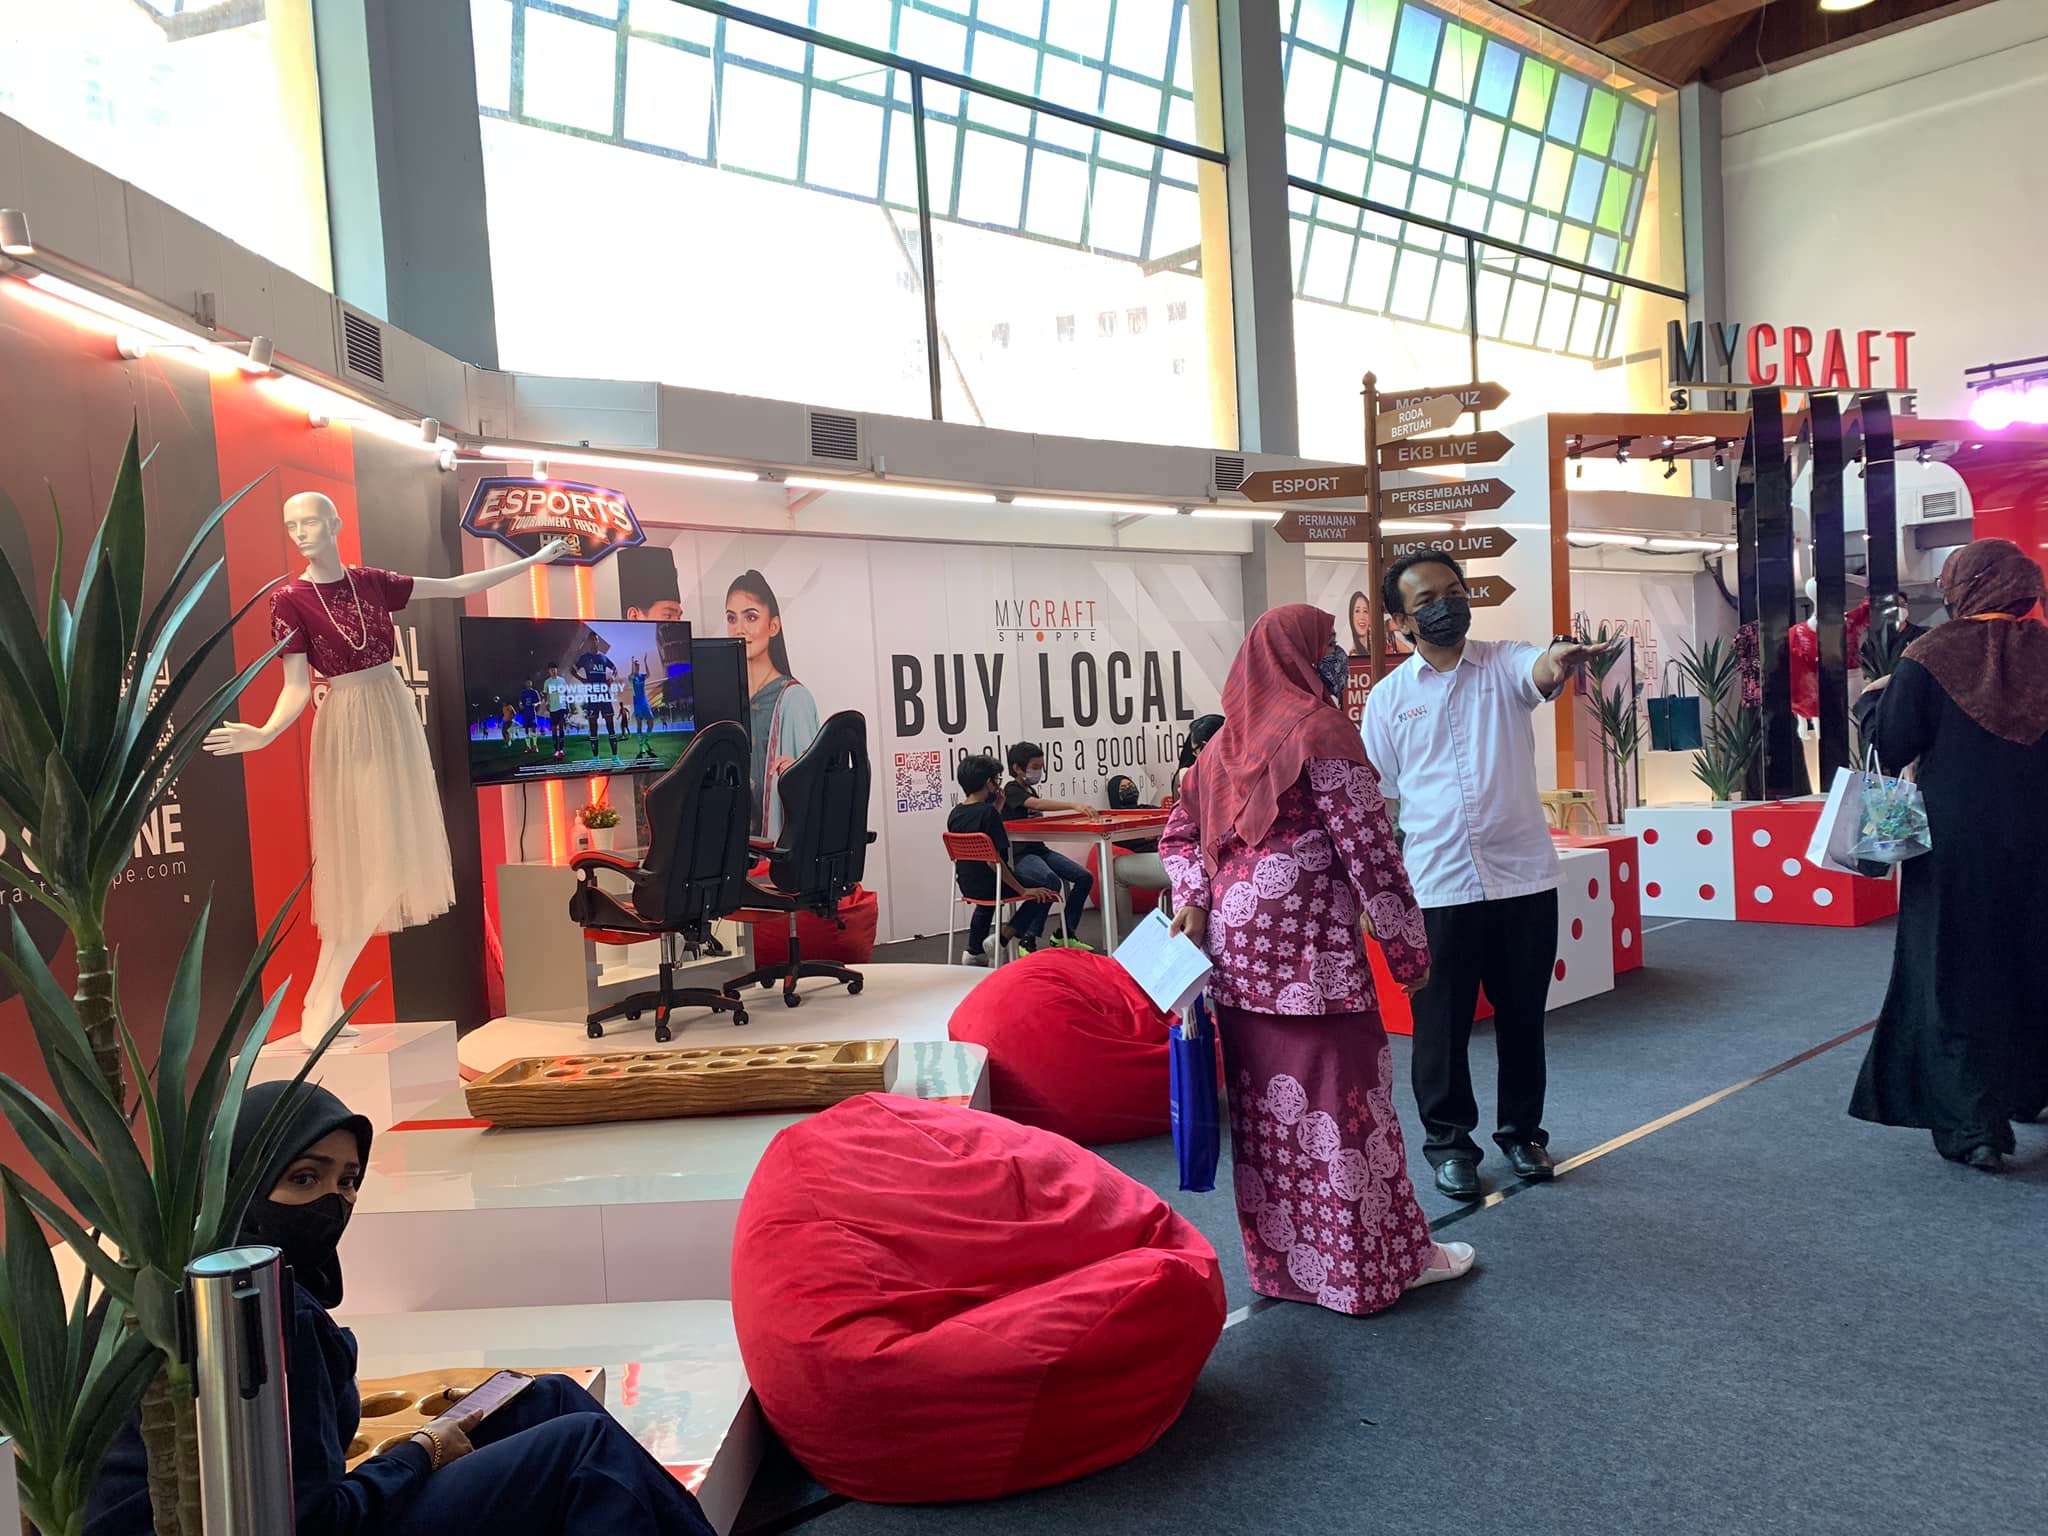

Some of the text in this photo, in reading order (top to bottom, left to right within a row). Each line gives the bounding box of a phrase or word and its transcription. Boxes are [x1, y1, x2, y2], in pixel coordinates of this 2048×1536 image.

[1667, 320, 1916, 390] MYCRAFT
[1399, 408, 1424, 423] RODA
[1391, 418, 1431, 438] BERTUAH
[1398, 441, 1478, 461] EKB LIVE
[1272, 477, 1340, 493] ESPORT
[1391, 483, 1489, 503] PERSEMBAHAN
[479, 488, 633, 531] ESPORTS
[1408, 498, 1473, 513] KESENIAN
[1298, 515, 1356, 526] PERMAINAN
[1309, 528, 1347, 539] RAKYAT
[1431, 539, 1454, 552] GO
[1459, 536, 1492, 550] LIVE
[995, 599, 1096, 628] MYCRAFT
[548, 683, 625, 694] POWERED BY
[891, 650, 1194, 737] BUY LOCAL
[559, 693, 617, 704] FOOTBALL
[1075, 739, 1085, 770] a
[1097, 726, 1146, 776] good
